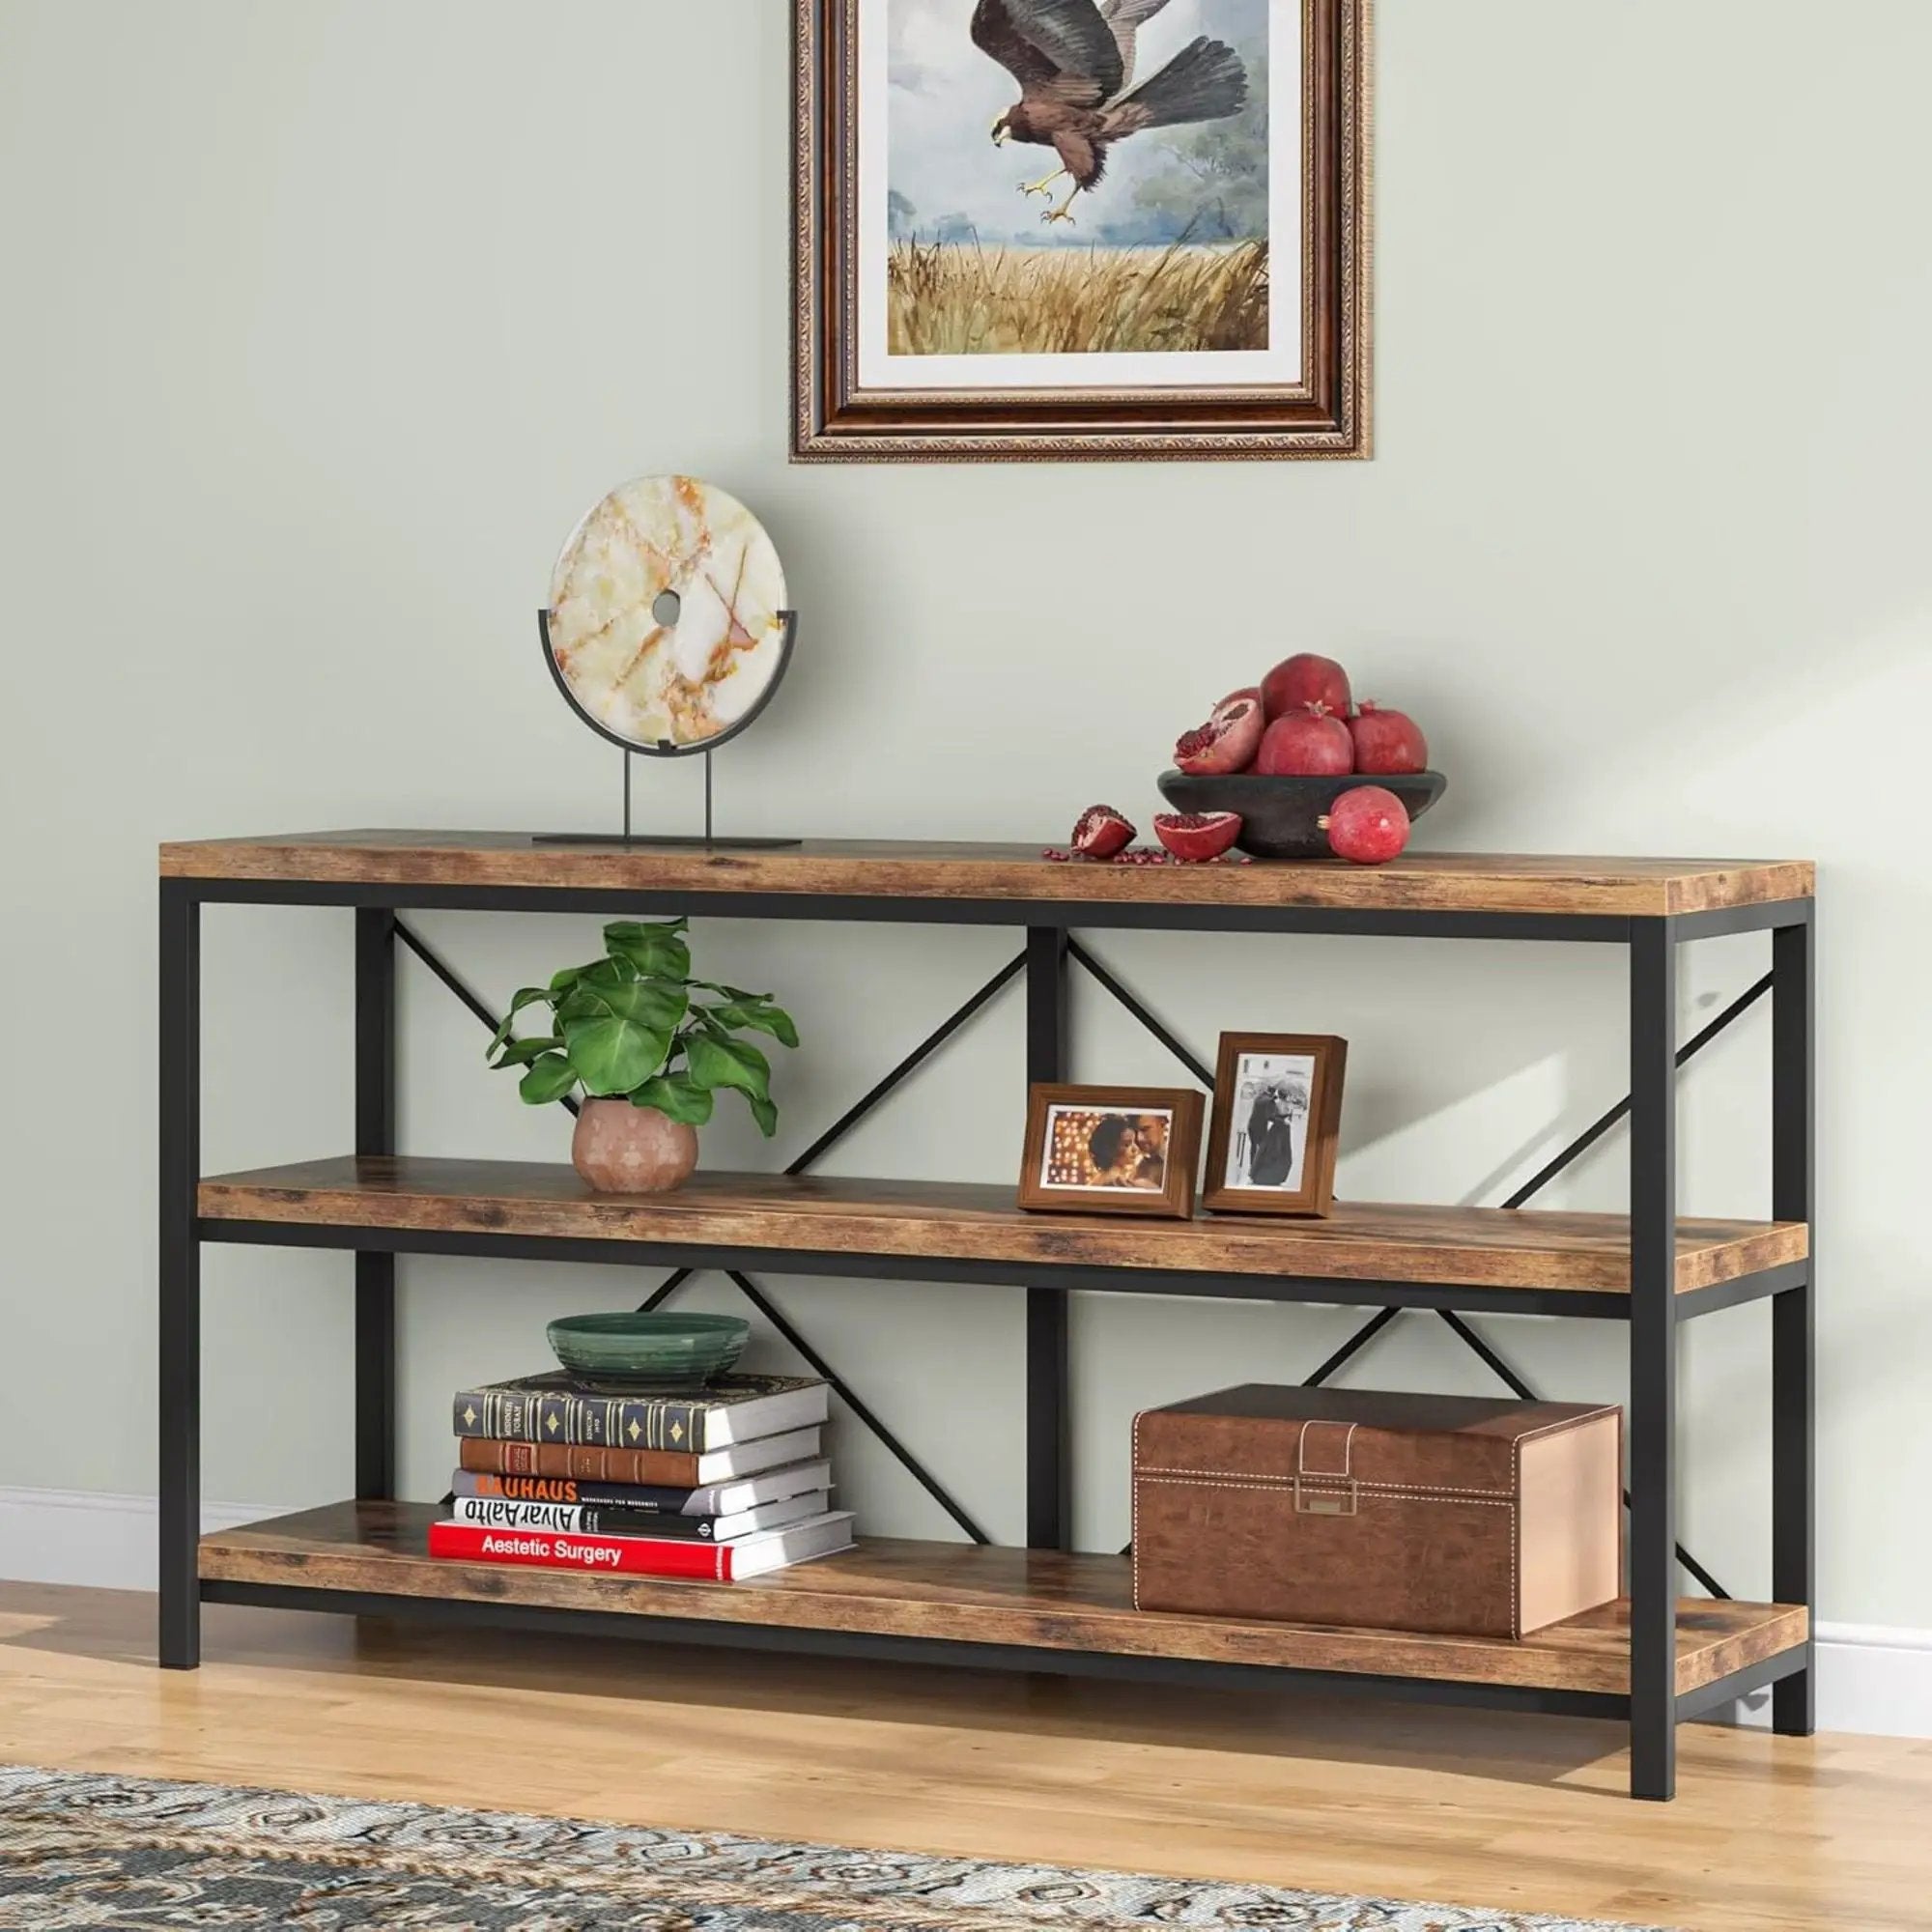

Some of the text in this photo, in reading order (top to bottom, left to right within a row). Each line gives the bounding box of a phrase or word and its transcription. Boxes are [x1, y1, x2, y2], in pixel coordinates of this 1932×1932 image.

[477, 1475, 578, 1502] BAUHAUS
[481, 1535, 622, 1567] Aestetic Surgery
